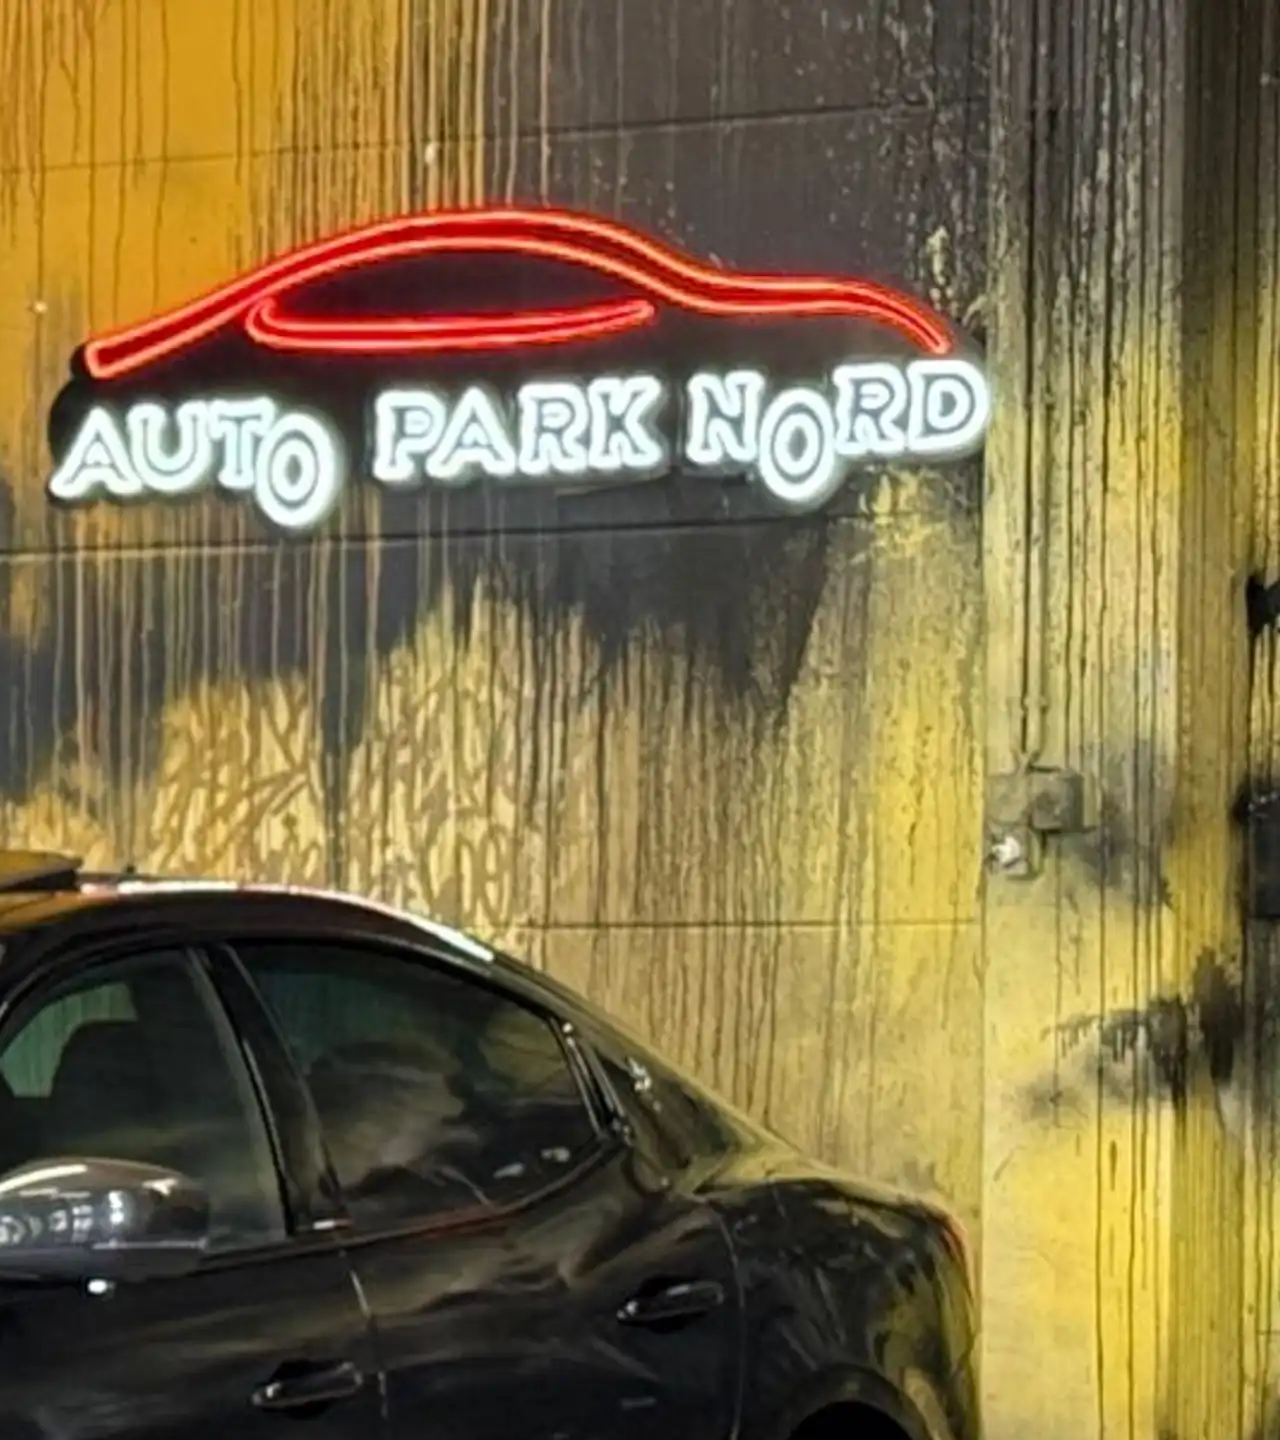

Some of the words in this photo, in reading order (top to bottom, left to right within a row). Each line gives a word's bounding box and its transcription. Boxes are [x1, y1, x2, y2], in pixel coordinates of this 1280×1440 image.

[49, 396, 339, 528] AUTO
[373, 376, 663, 482] PARK
[686, 358, 992, 503] NORD
